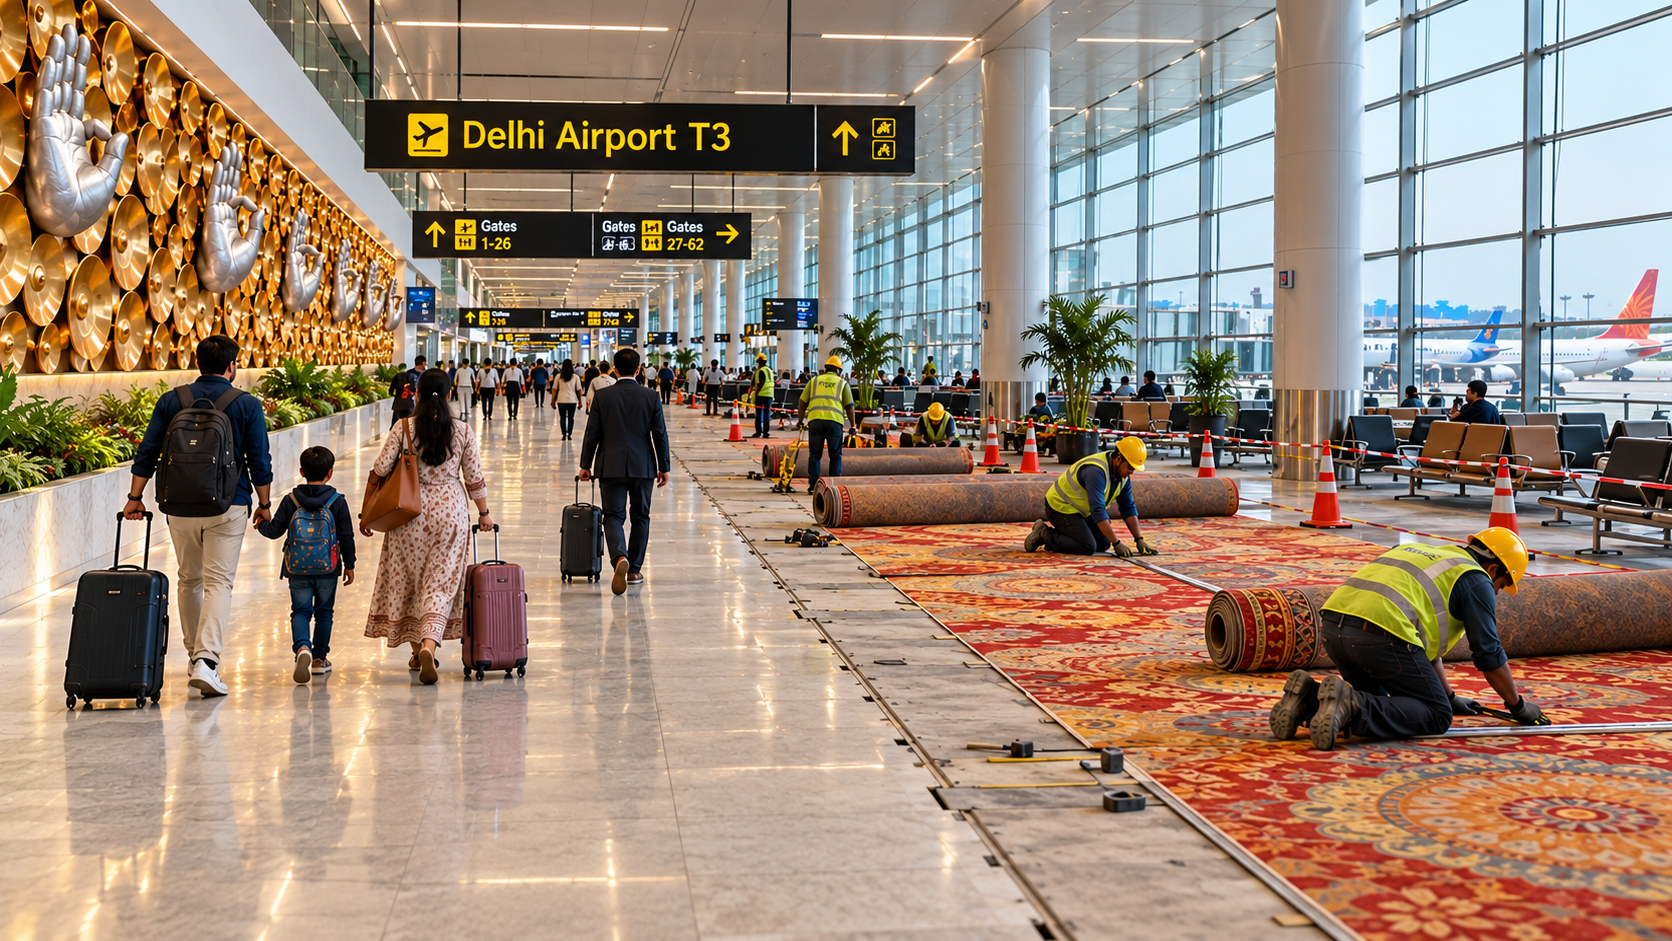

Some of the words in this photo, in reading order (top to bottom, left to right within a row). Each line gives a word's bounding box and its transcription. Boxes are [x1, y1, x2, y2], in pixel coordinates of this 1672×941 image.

[463, 119, 545, 150] Delhi
[555, 120, 677, 158] Airport
[688, 122, 731, 152] T3
[480, 219, 518, 233] Gates
[602, 220, 636, 233] Gates
[666, 220, 704, 233] Gates
[481, 236, 512, 251] 1-26
[666, 237, 704, 251] 27-62
